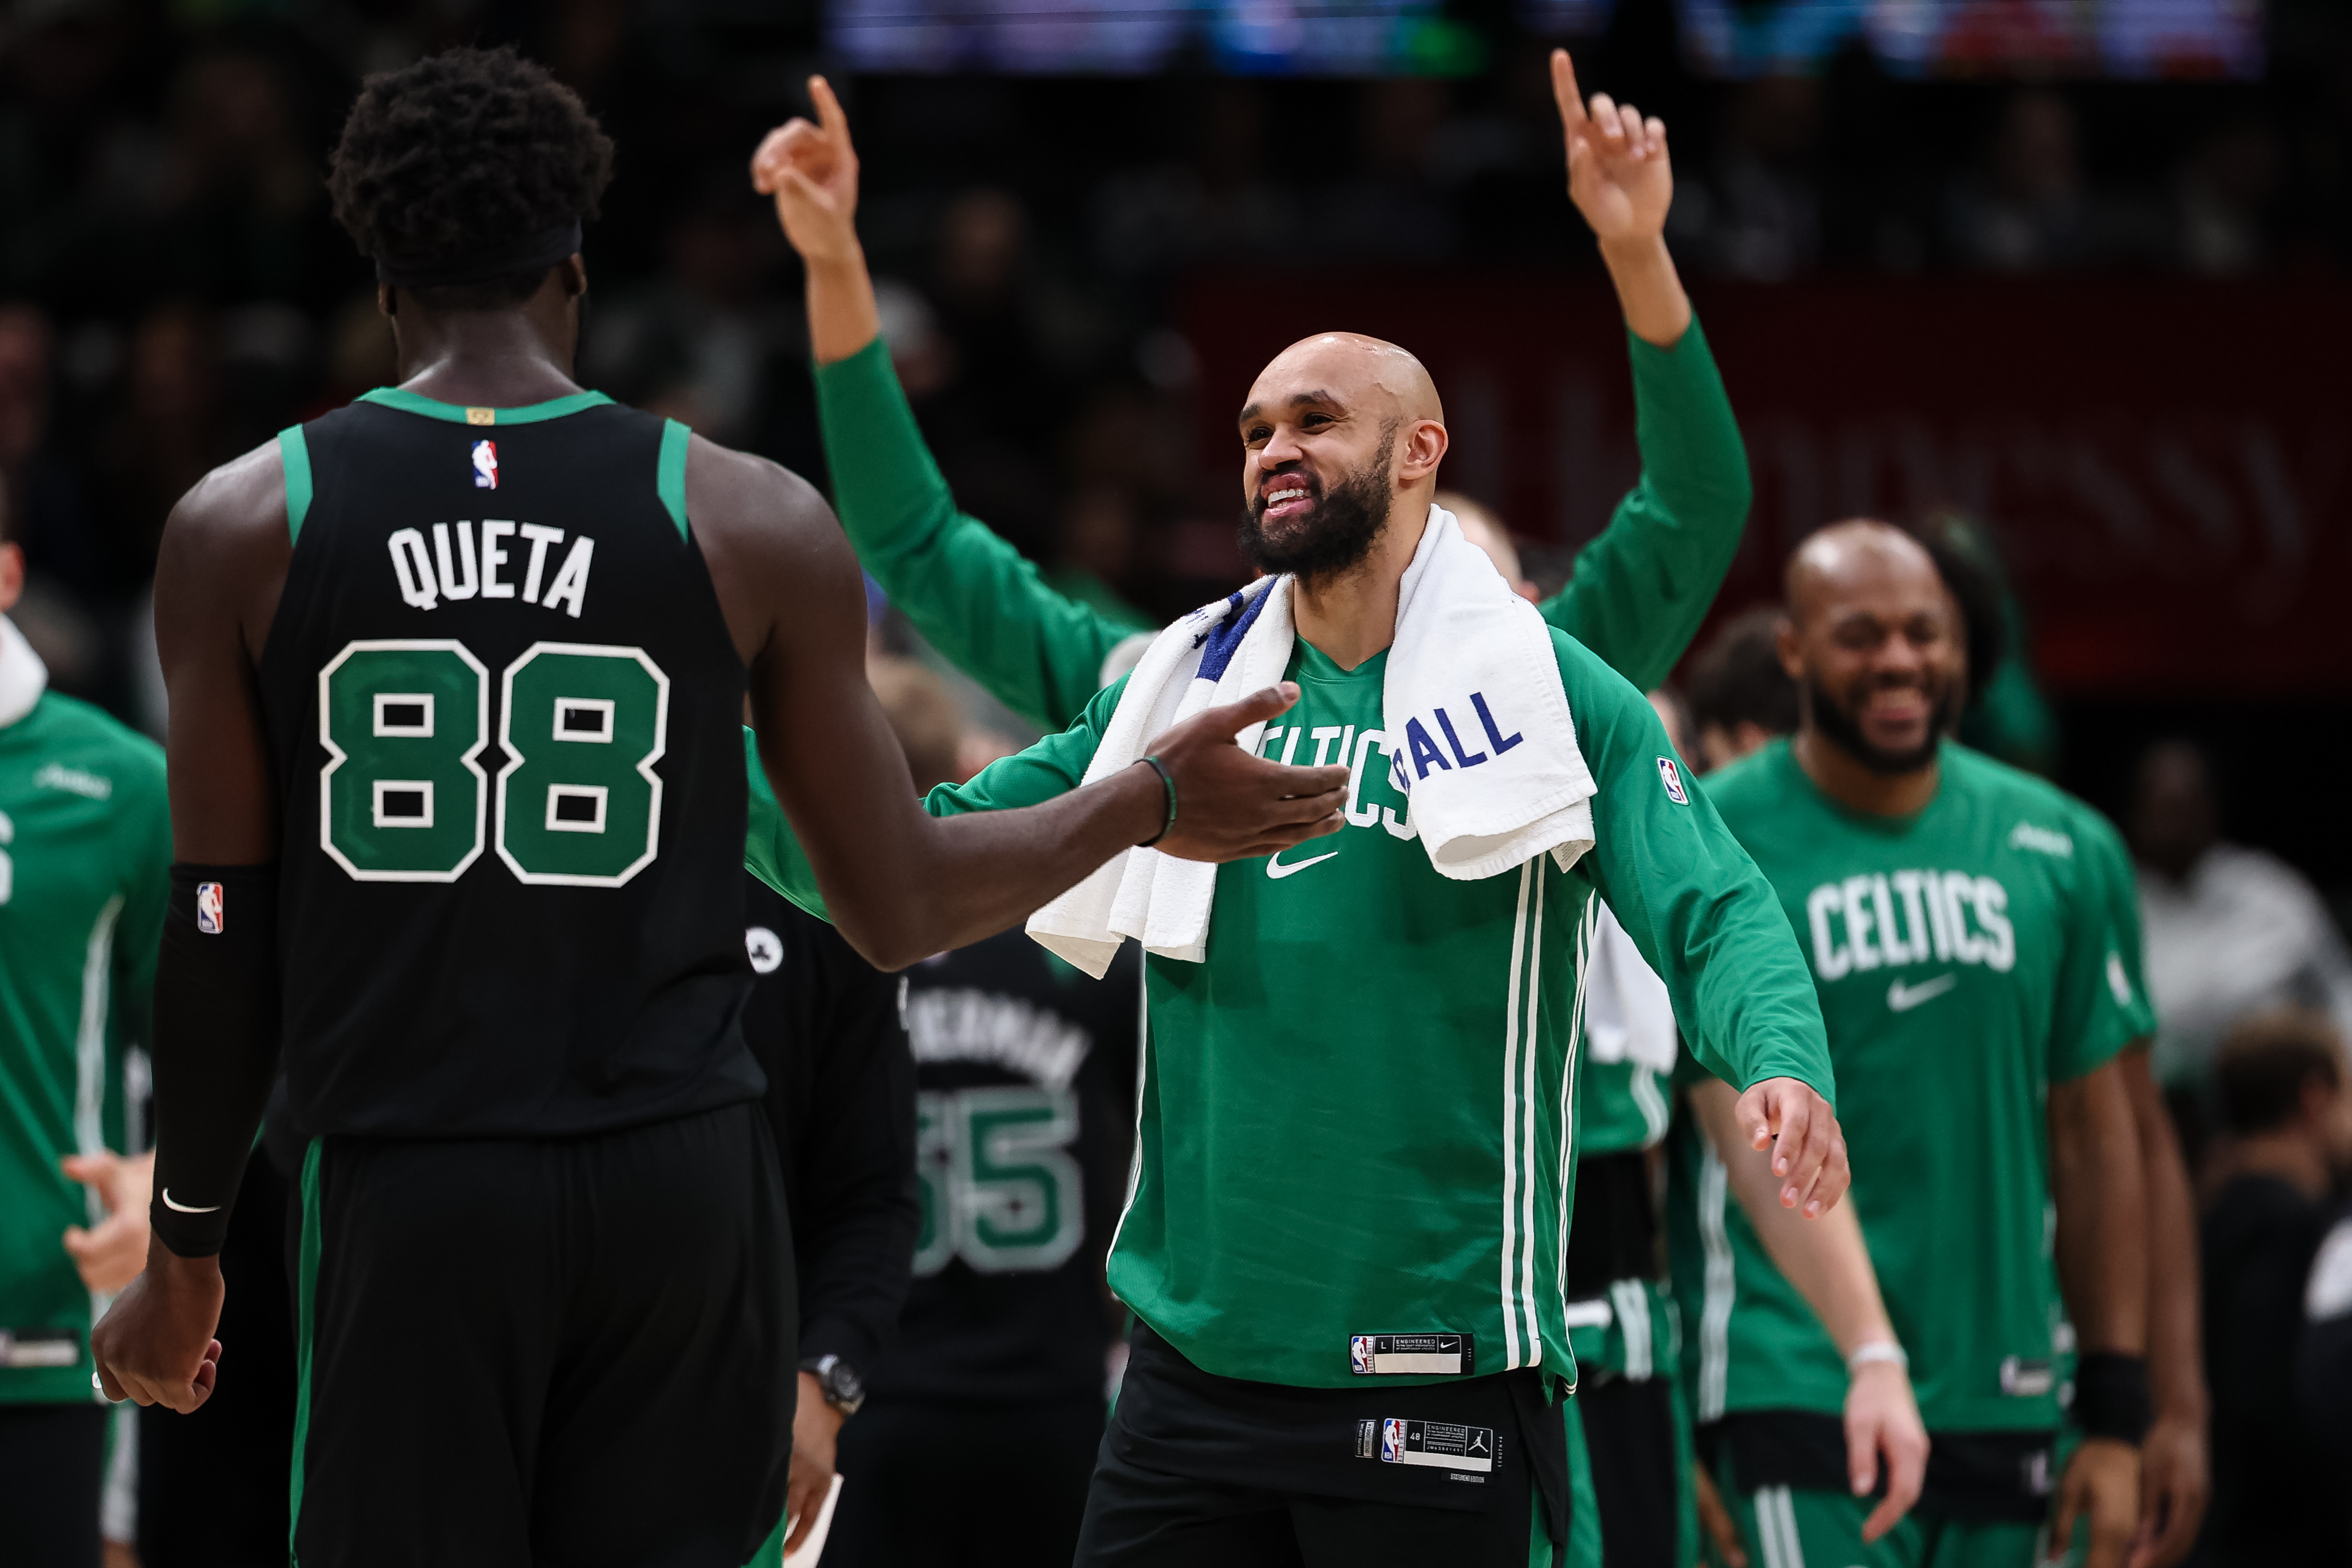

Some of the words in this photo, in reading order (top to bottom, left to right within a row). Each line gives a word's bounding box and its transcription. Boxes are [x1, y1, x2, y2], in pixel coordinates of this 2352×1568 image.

[387, 519, 595, 619] QUETA
[318, 638, 670, 888] 88
[1806, 867, 2016, 983] CELTICS
[1410, 1432, 1421, 1441] 48
[1427, 1425, 1465, 1433] ENGINEERED
